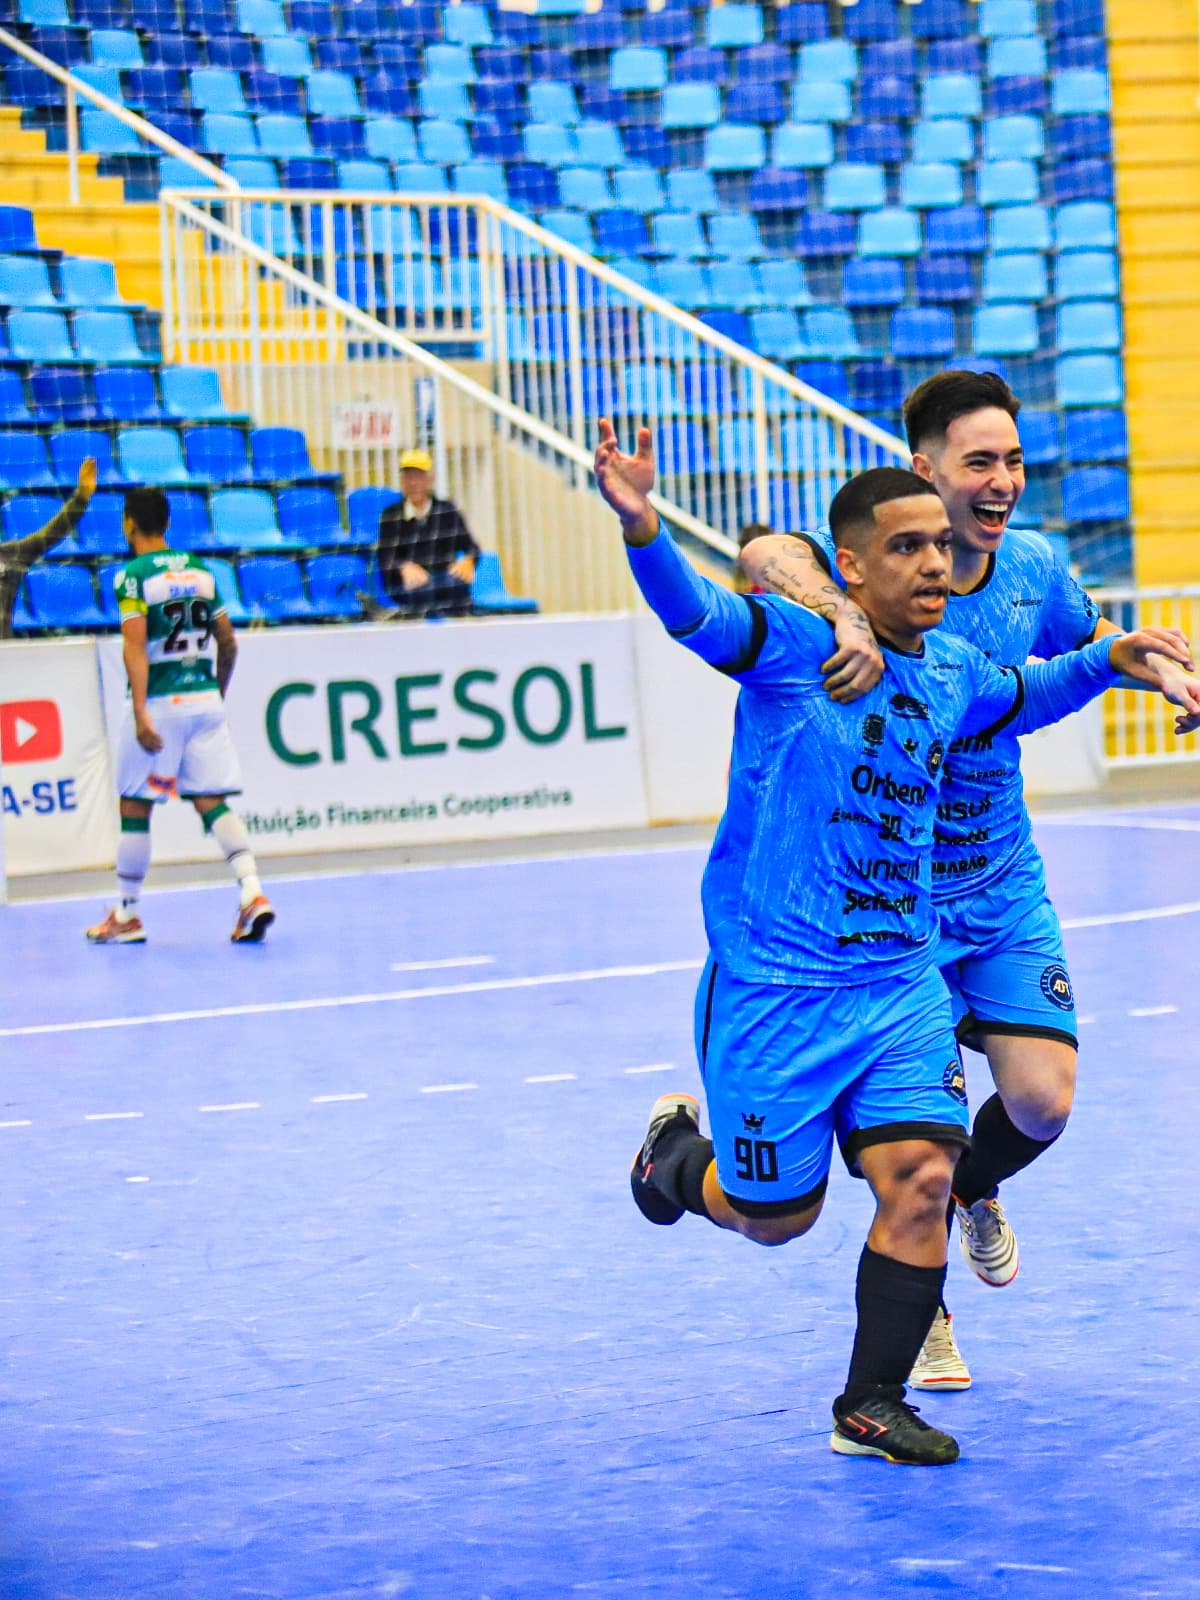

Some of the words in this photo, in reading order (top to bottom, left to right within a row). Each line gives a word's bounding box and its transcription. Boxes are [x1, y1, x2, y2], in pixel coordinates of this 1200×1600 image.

[163, 601, 212, 654] 29
[265, 662, 626, 766] CRESOL
[245, 804, 321, 836] ituição
[327, 803, 438, 827] Financeira
[444, 784, 574, 820] Cooperativa
[735, 1136, 779, 1183] 90
